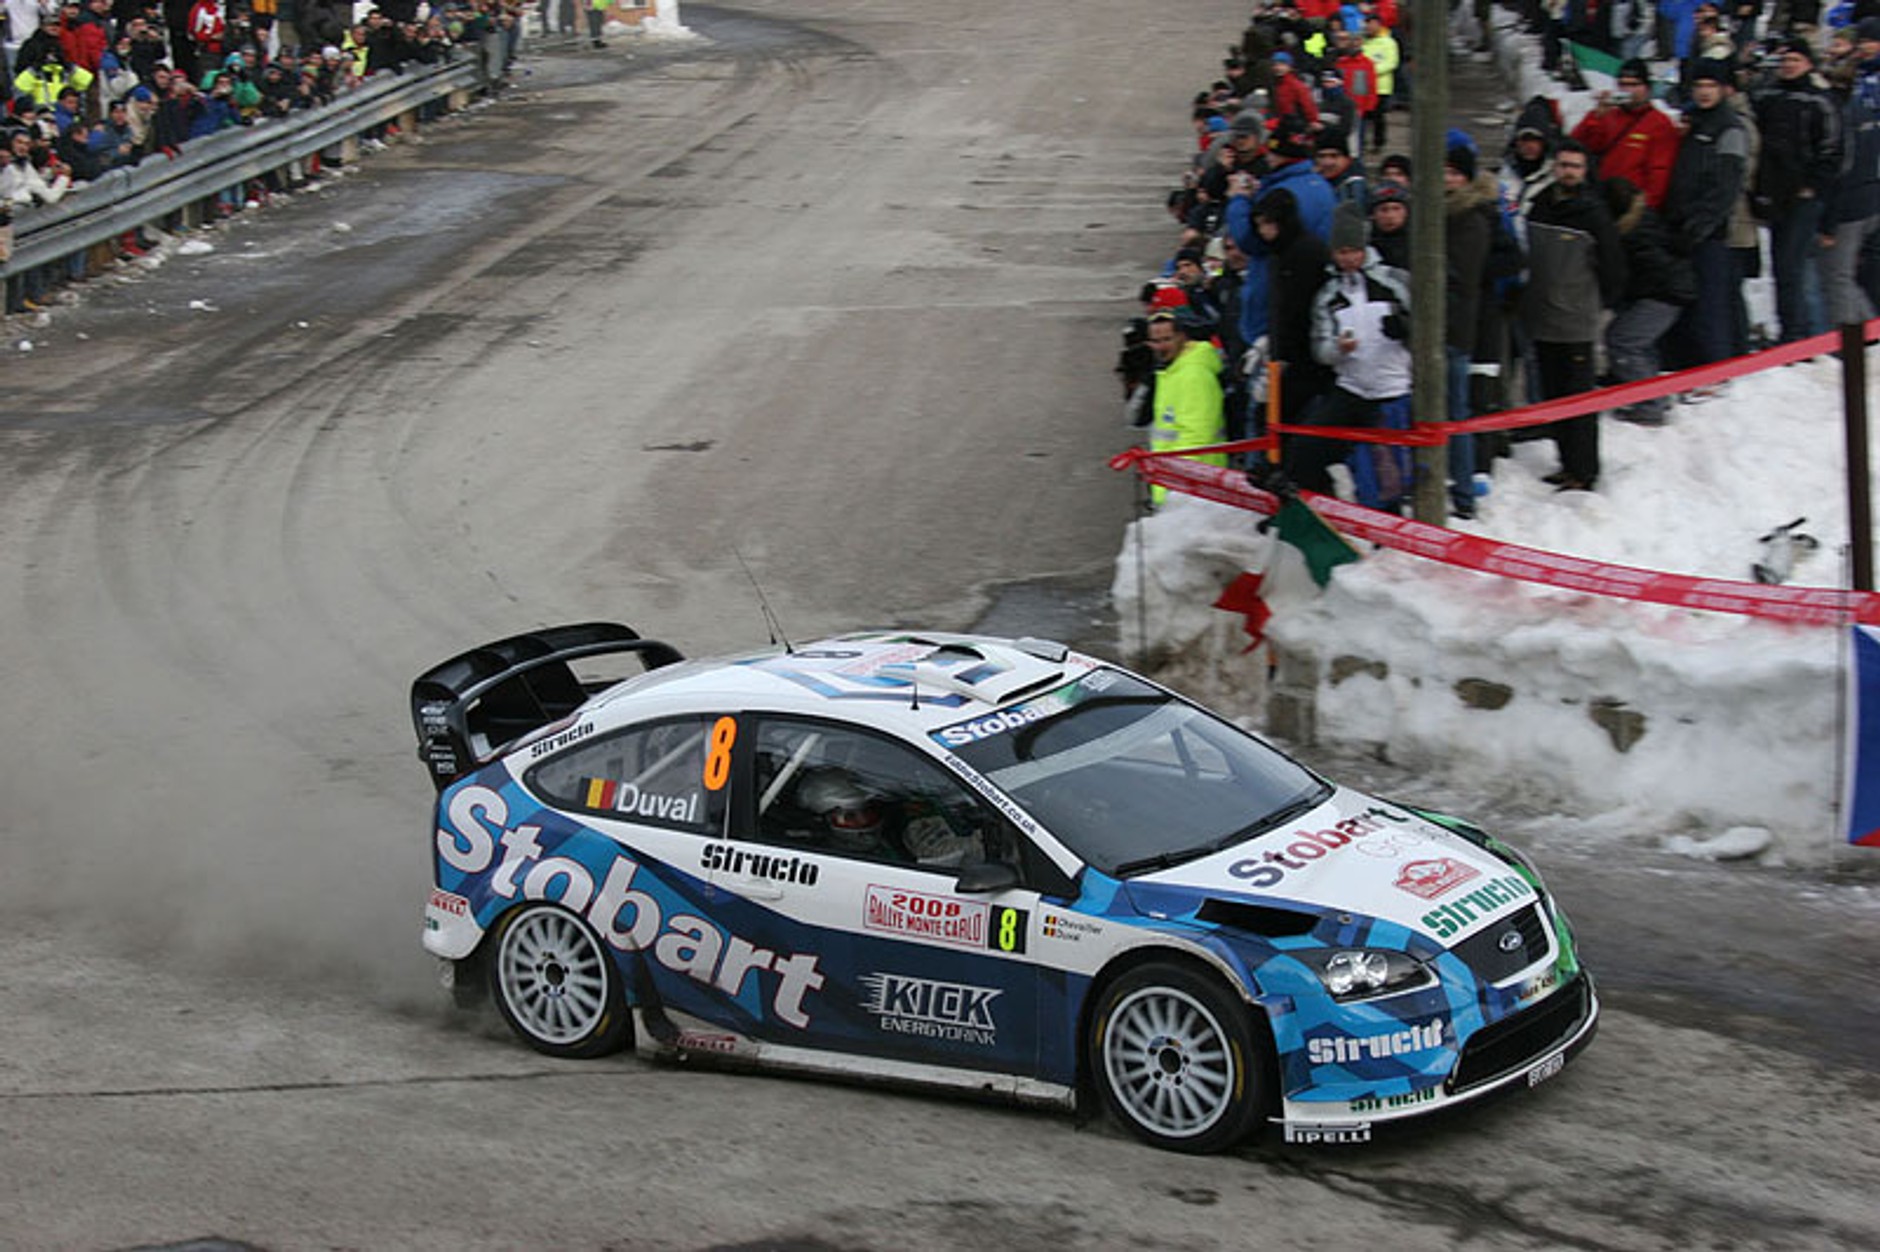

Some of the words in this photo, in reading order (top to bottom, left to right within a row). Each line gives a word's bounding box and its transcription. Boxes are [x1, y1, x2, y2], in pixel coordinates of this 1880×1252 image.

[530, 721, 595, 758] Structo
[940, 700, 1052, 745] Stobar
[703, 716, 737, 791] 8
[617, 783, 698, 822] Duval
[701, 843, 819, 886] Structo
[1228, 806, 1408, 887] Stobart
[437, 785, 825, 1029] Stobart
[869, 893, 903, 929] RALLYE
[906, 914, 942, 937] MONTE
[944, 913, 983, 942] CARLO
[891, 893, 961, 918] 2008
[1421, 875, 1531, 938] Structo
[998, 908, 1018, 952] 8
[880, 977, 1003, 1030] KICK
